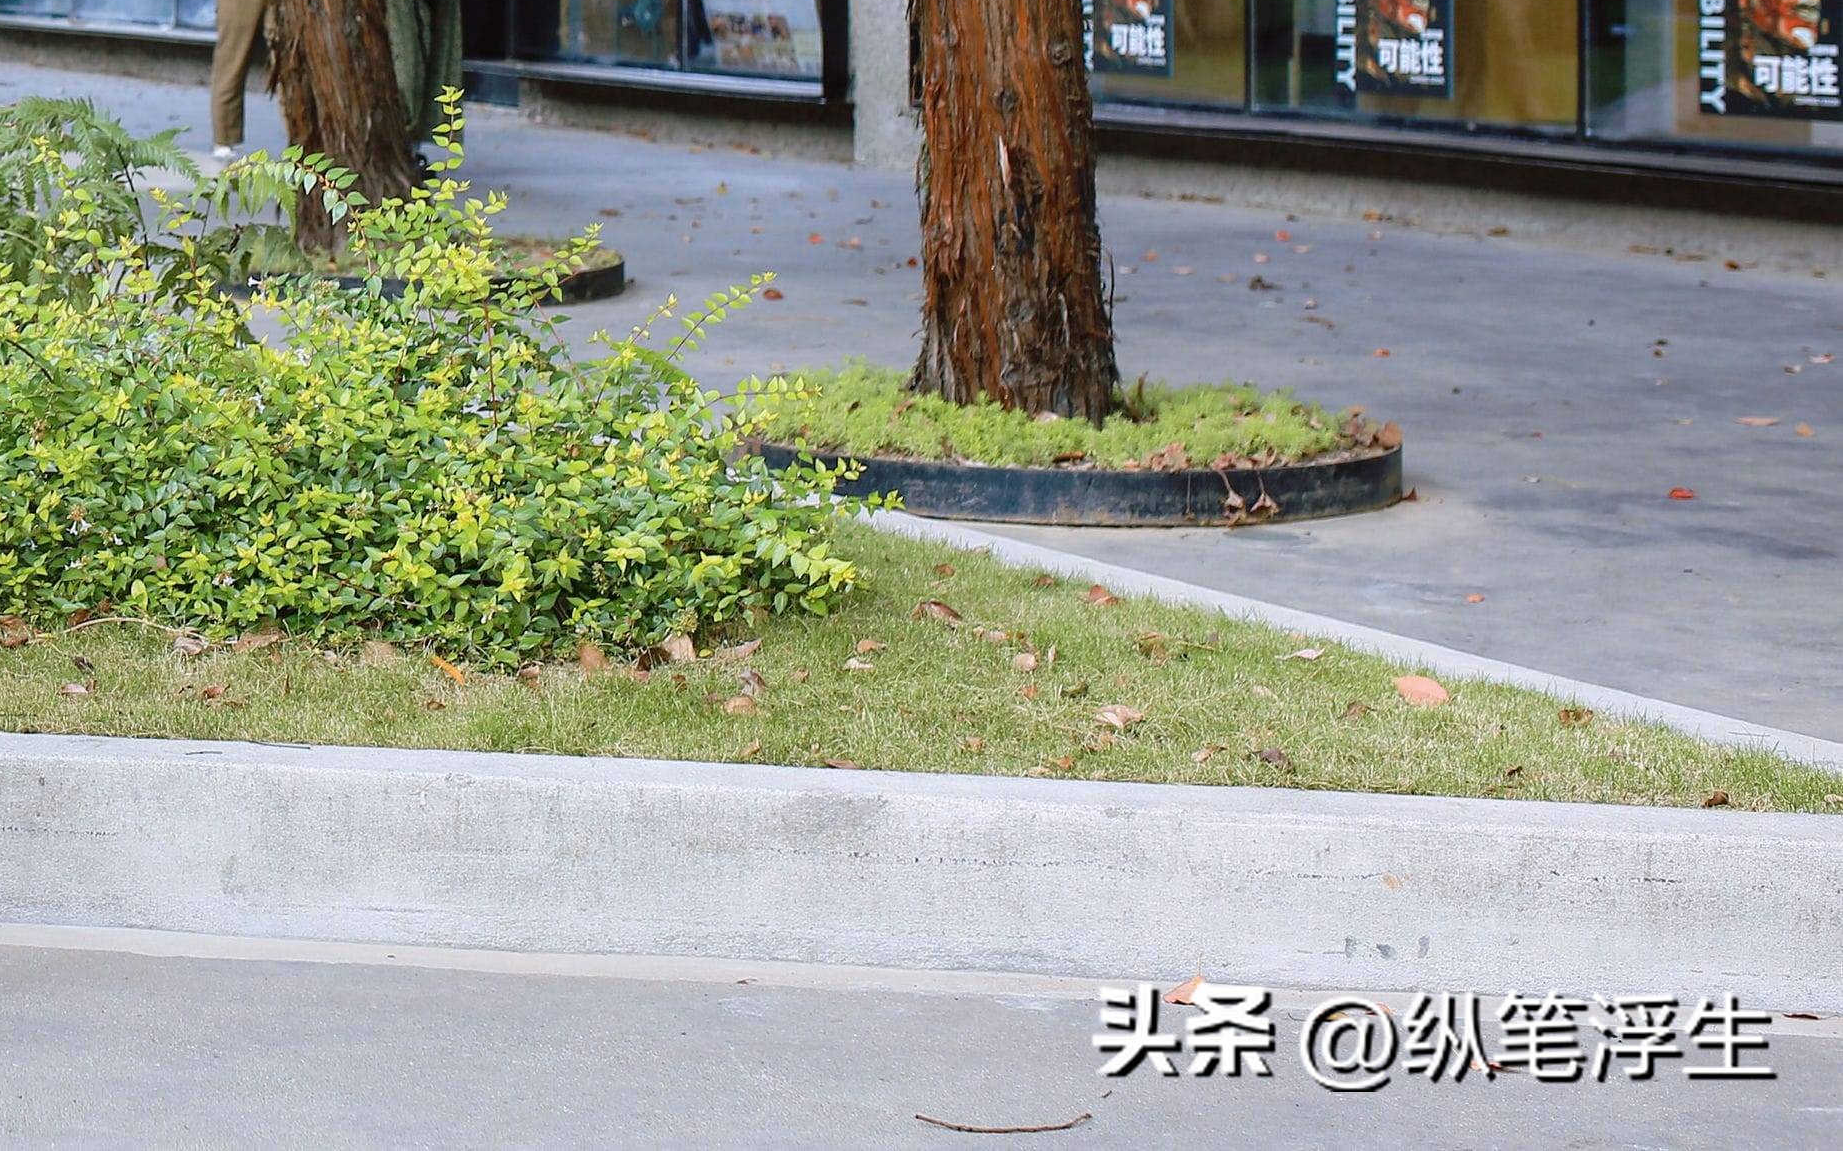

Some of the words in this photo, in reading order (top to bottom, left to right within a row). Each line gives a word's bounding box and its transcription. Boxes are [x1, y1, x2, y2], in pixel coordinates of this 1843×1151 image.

[1110, 22, 1165, 57] 可能性
[1377, 38, 1444, 75] 可能性
[1752, 55, 1840, 96] 可能性
